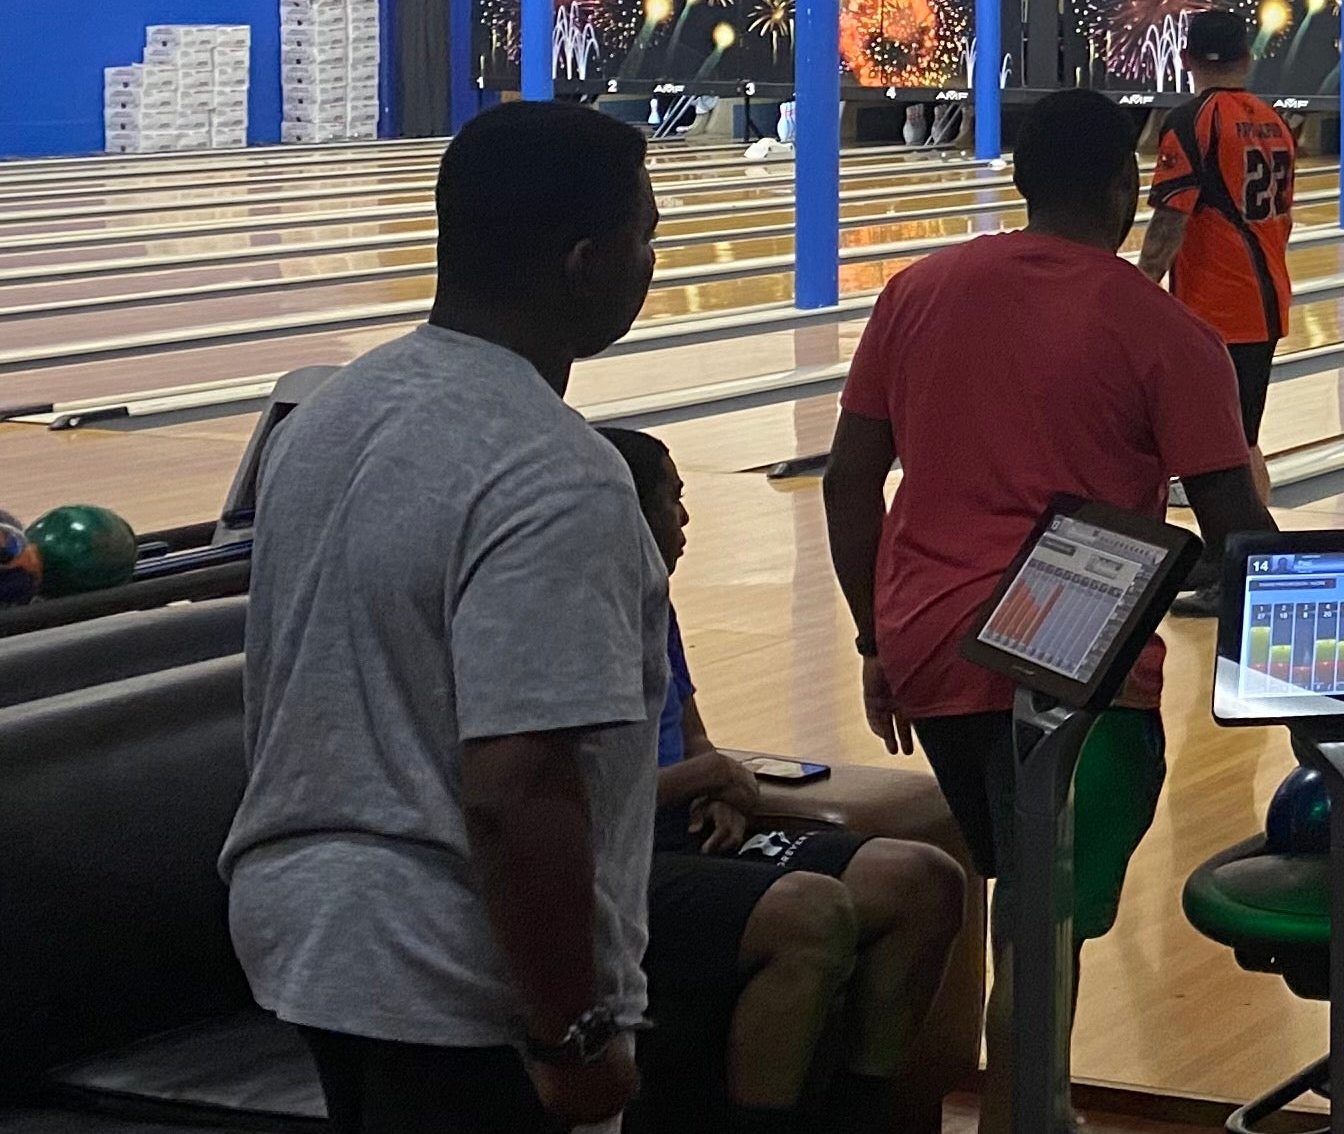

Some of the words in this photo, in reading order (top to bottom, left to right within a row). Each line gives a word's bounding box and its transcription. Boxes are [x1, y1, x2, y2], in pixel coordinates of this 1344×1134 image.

[476, 76, 484, 89] 1
[607, 79, 618, 94] 2
[653, 84, 686, 94] AMF
[745, 82, 756, 96] 3
[886, 86, 897, 100] 4
[935, 90, 969, 100] AMF
[1119, 94, 1155, 105] AMF
[1273, 98, 1309, 109] AMF
[1252, 560, 1270, 572] 14
